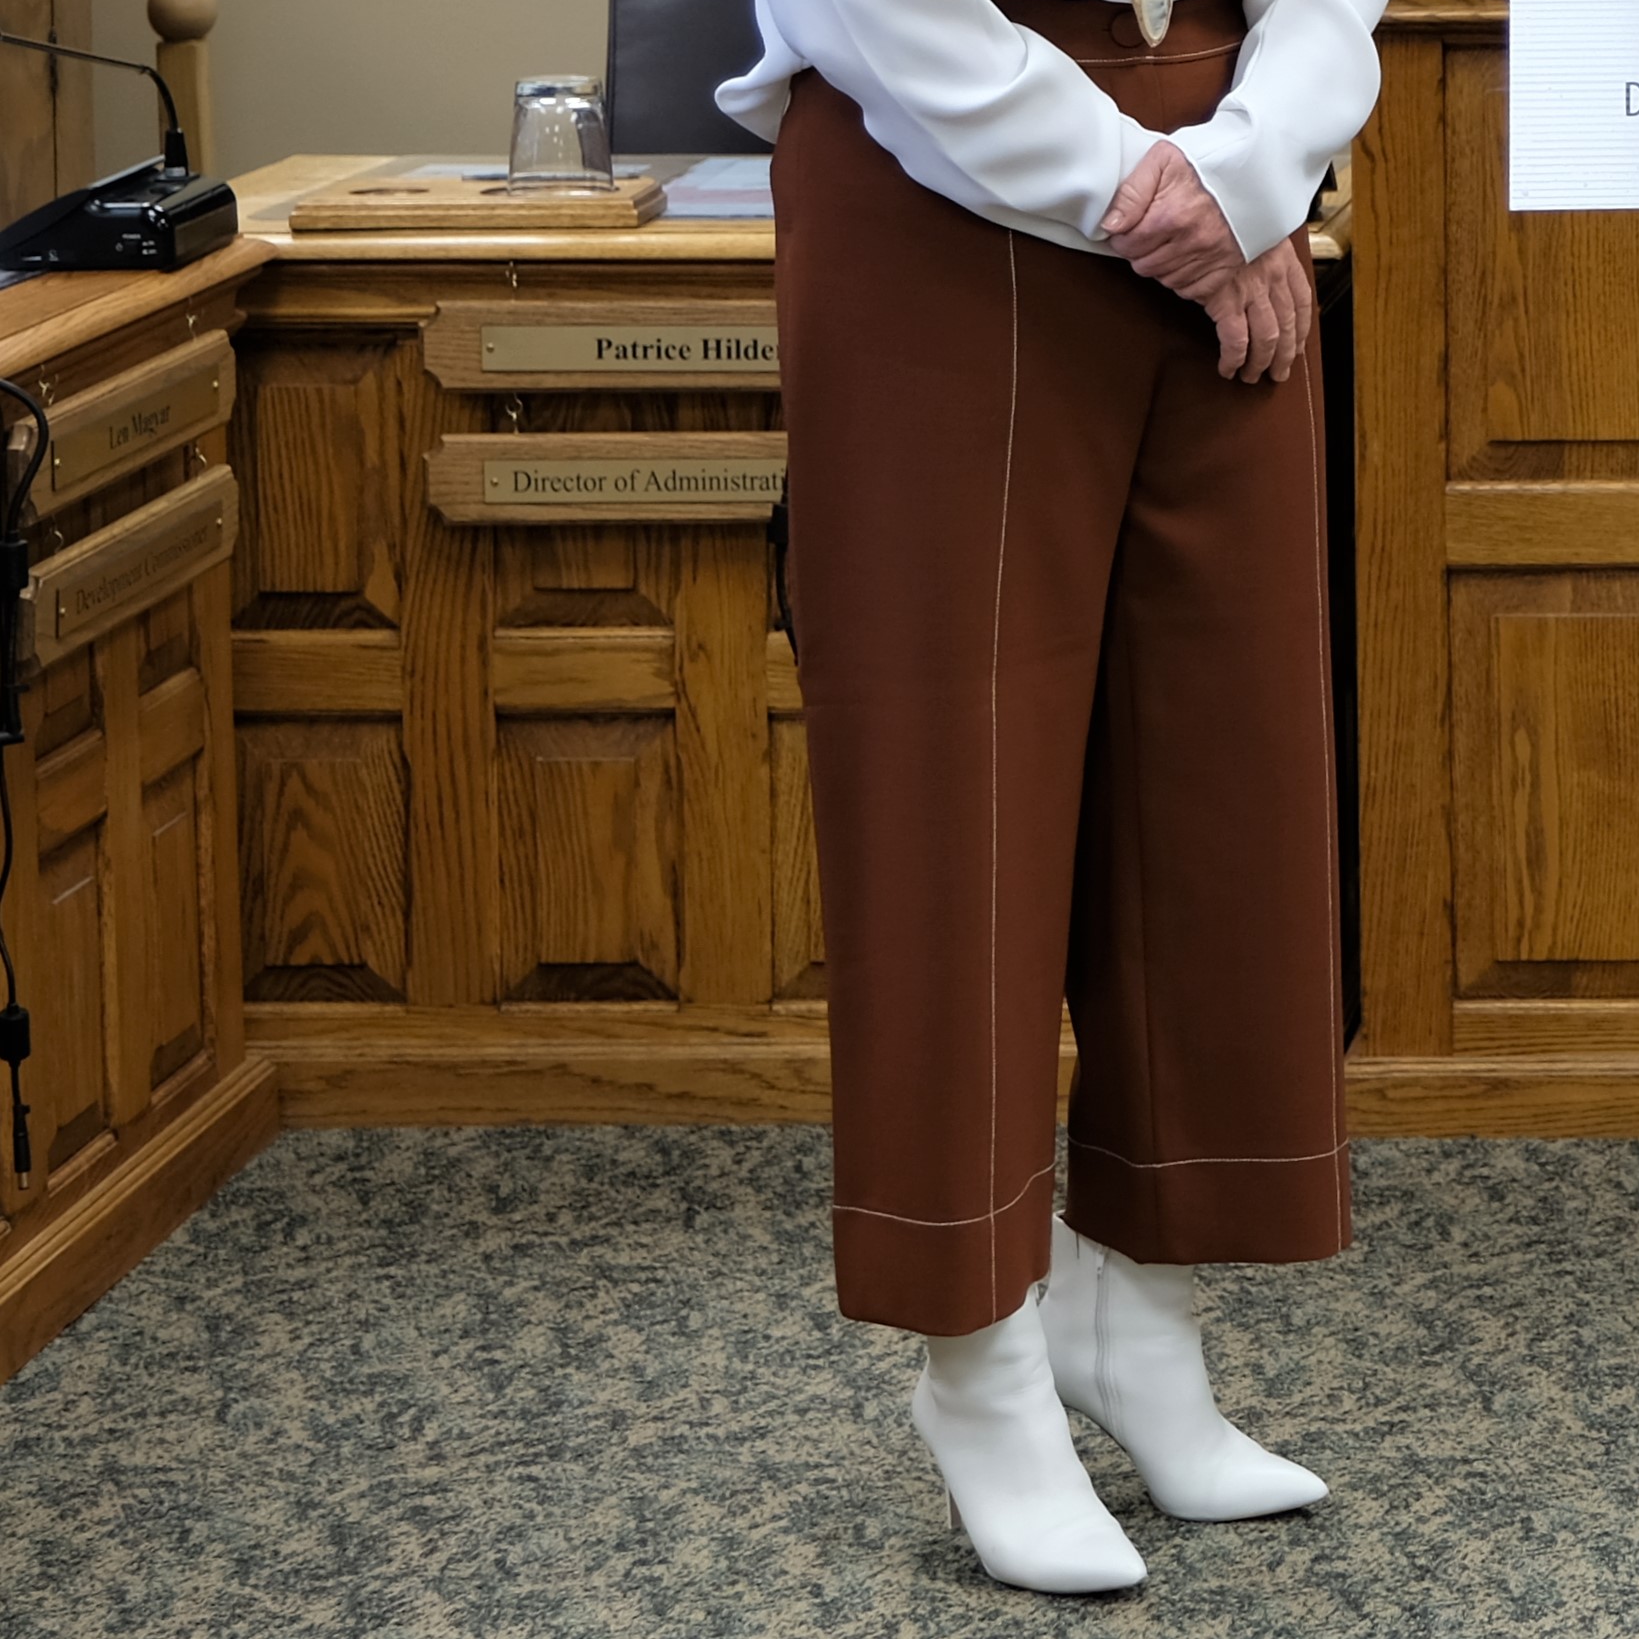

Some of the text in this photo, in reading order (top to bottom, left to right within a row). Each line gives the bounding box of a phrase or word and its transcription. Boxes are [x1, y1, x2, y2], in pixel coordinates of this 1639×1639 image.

[596, 337, 780, 361] Patrice Hilde
[109, 425, 129, 450] Len
[513, 470, 608, 493] Director
[614, 469, 641, 493] of
